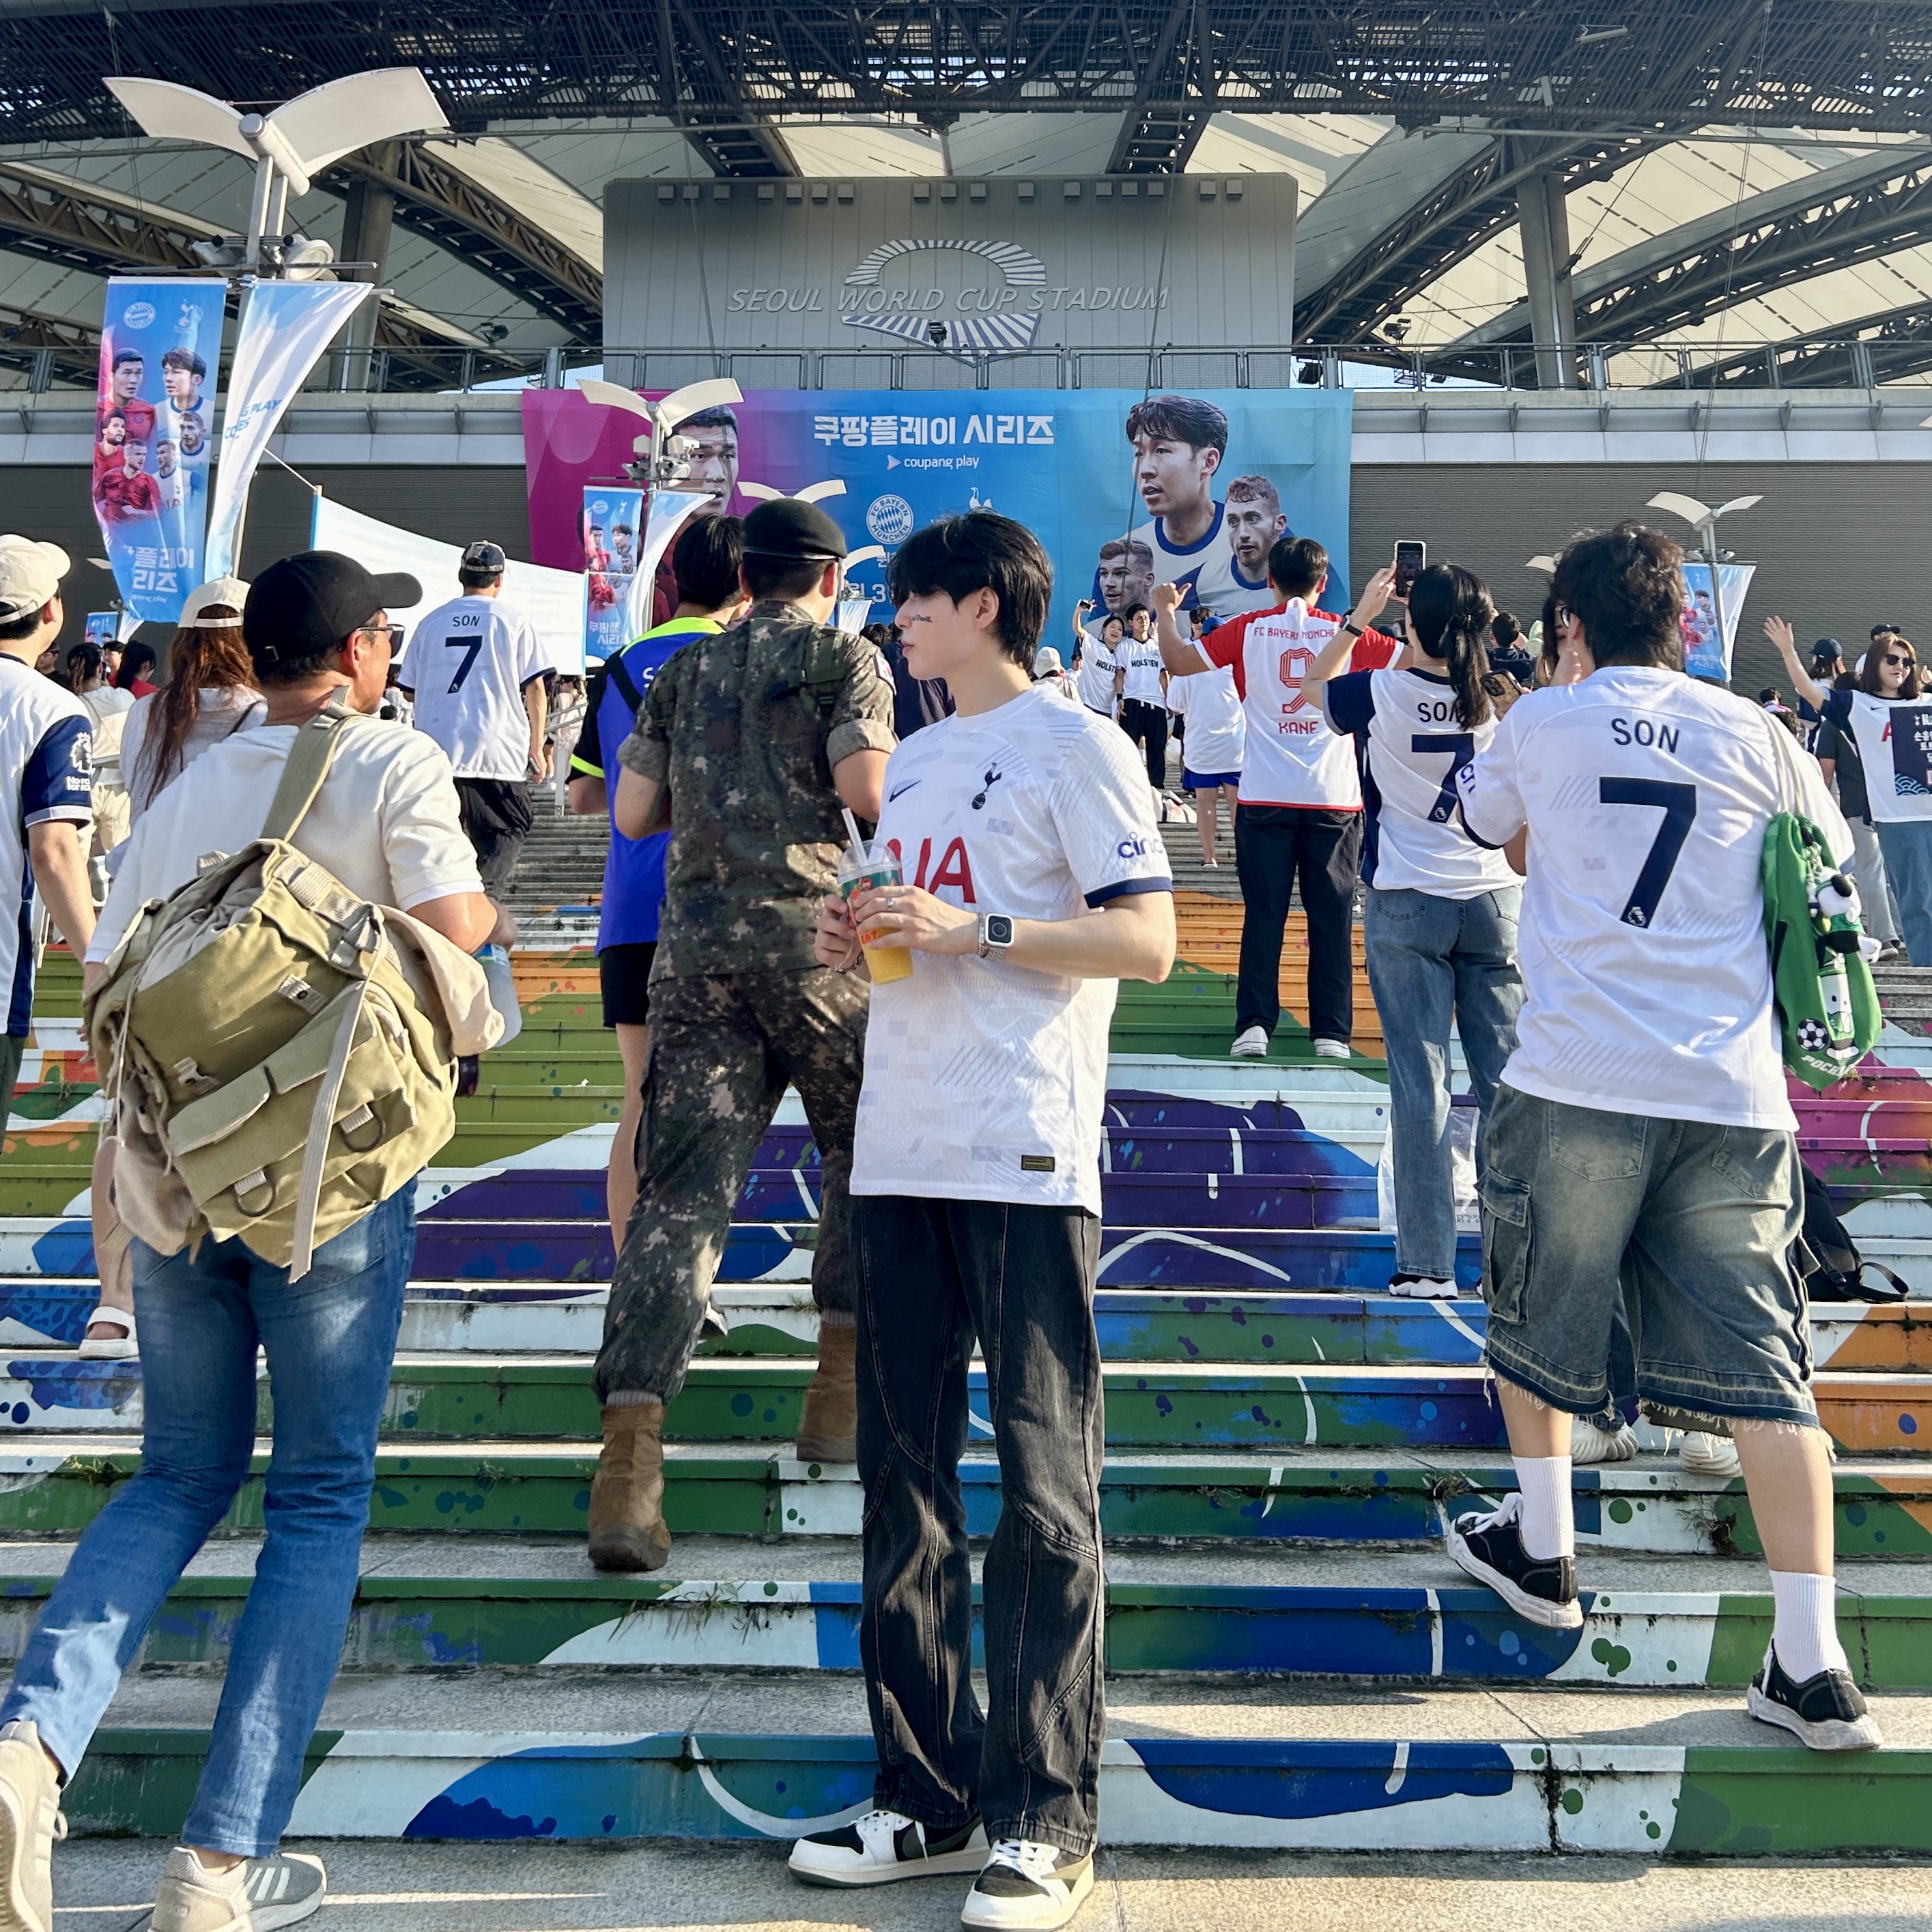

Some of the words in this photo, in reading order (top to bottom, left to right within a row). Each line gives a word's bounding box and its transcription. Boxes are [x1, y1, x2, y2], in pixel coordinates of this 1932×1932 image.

[727, 288, 823, 313] SEOUL
[837, 288, 946, 313] WORLD
[956, 287, 1018, 312] CUP
[1025, 287, 1169, 311] STADIUM
[814, 415, 956, 447] 쿠팡플레이
[963, 414, 1055, 444] 시리즈
[904, 457, 954, 470] coupang
[956, 455, 980, 470] play
[870, 505, 879, 517] FC
[879, 498, 909, 517] BAYERN
[130, 546, 195, 569] 플레이
[132, 568, 178, 593] 리즈
[872, 583, 891, 603] 3
[452, 615, 481, 627] SON
[1253, 627, 1264, 636] FC
[597, 634, 623, 644] 시리
[445, 635, 483, 694] 7
[1131, 659, 1159, 668] HOLSTEN
[1279, 647, 1316, 714] 9
[1417, 701, 1458, 723] SO
[1279, 721, 1320, 735] KANE
[1611, 718, 1680, 754] SON
[1411, 733, 1475, 824] 7
[1118, 832, 1163, 858] cinc
[1598, 776, 1698, 929] 7
